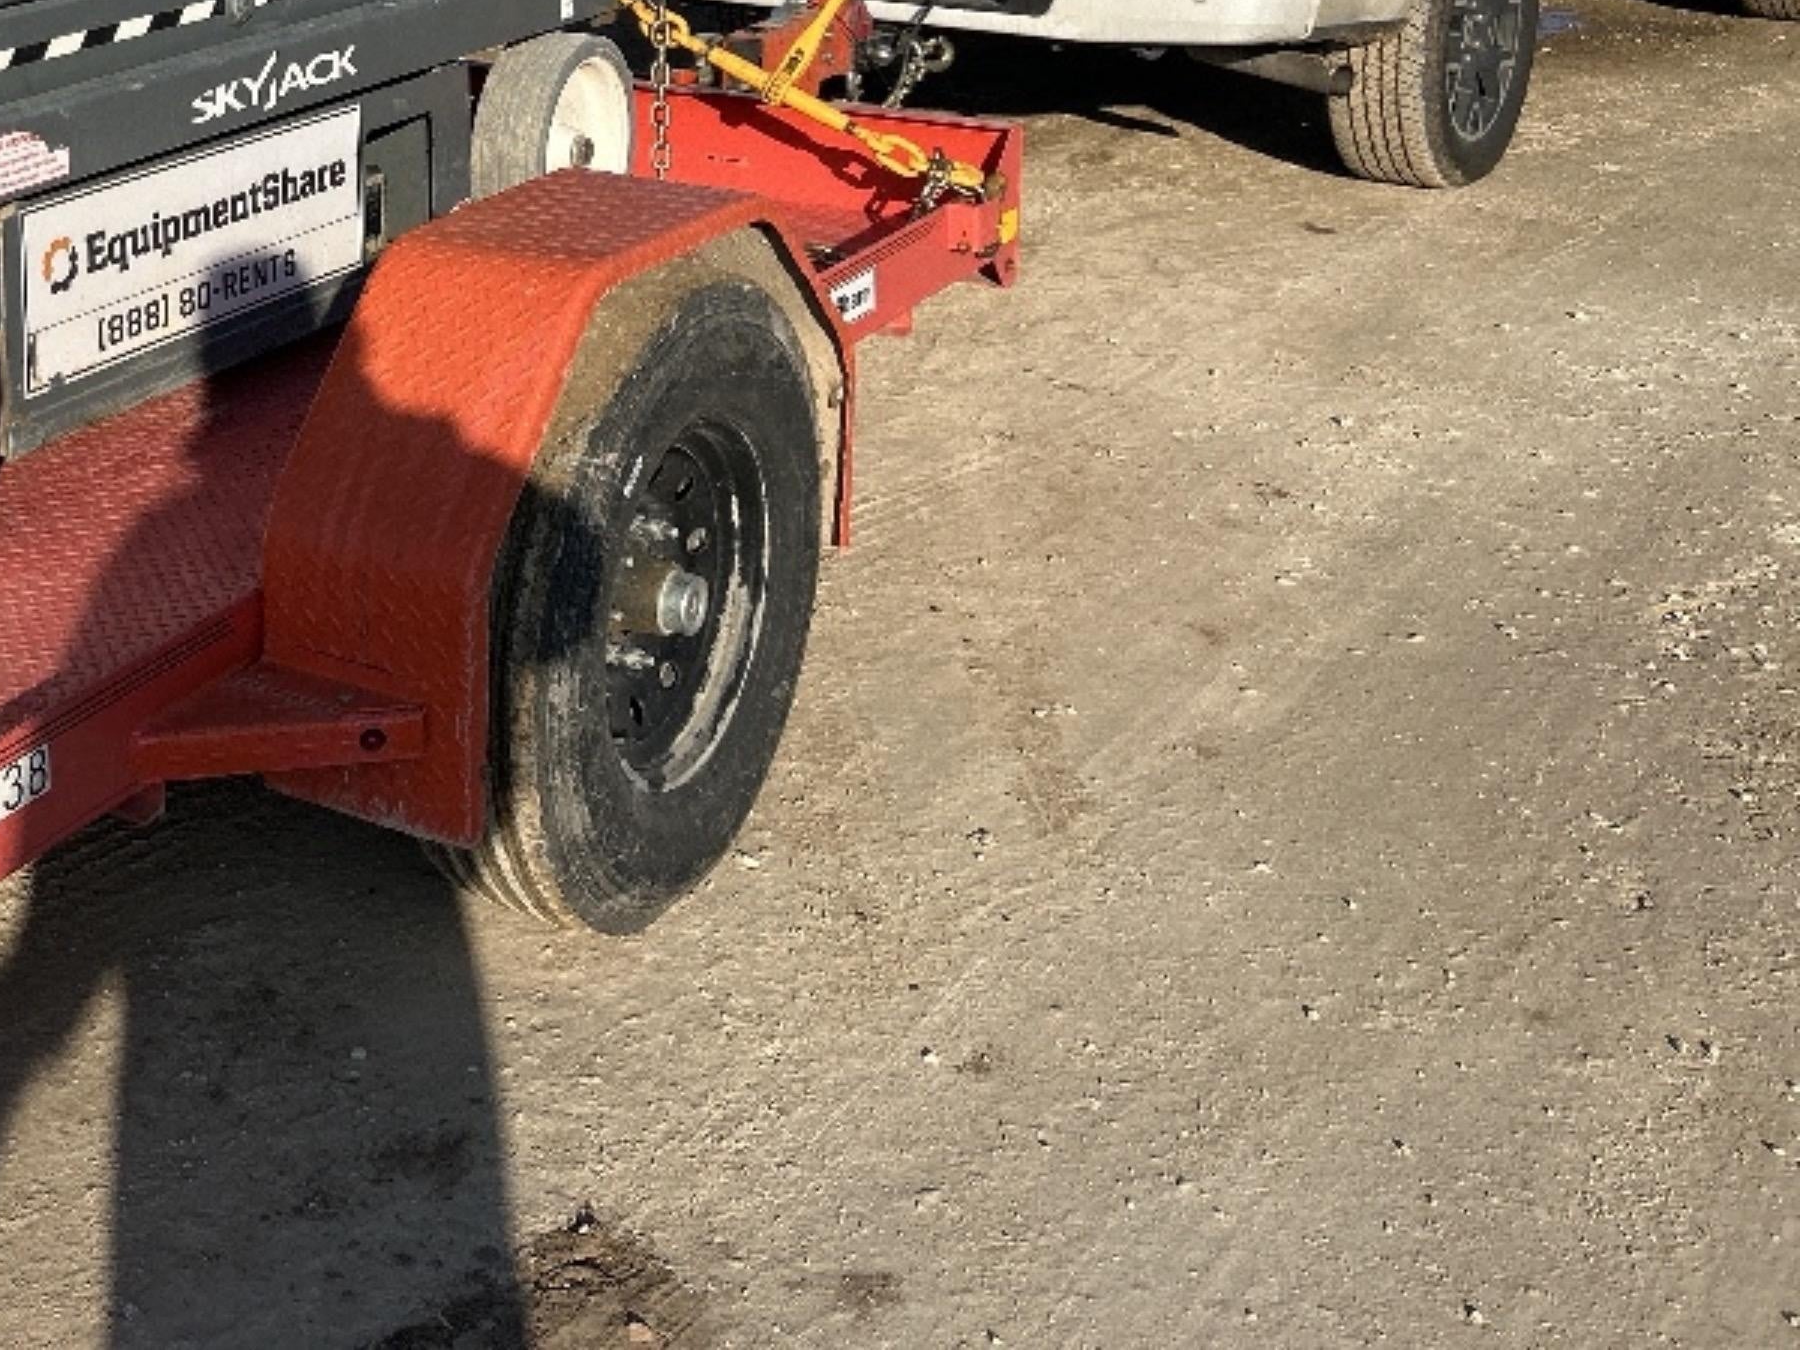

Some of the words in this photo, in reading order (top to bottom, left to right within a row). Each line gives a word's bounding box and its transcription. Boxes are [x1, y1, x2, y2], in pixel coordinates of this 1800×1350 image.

[191, 44, 358, 125] SKYJACK
[85, 158, 347, 274] EquipmentShare
[97, 293, 171, 351] (888)
[179, 247, 297, 319] 80-RENTS
